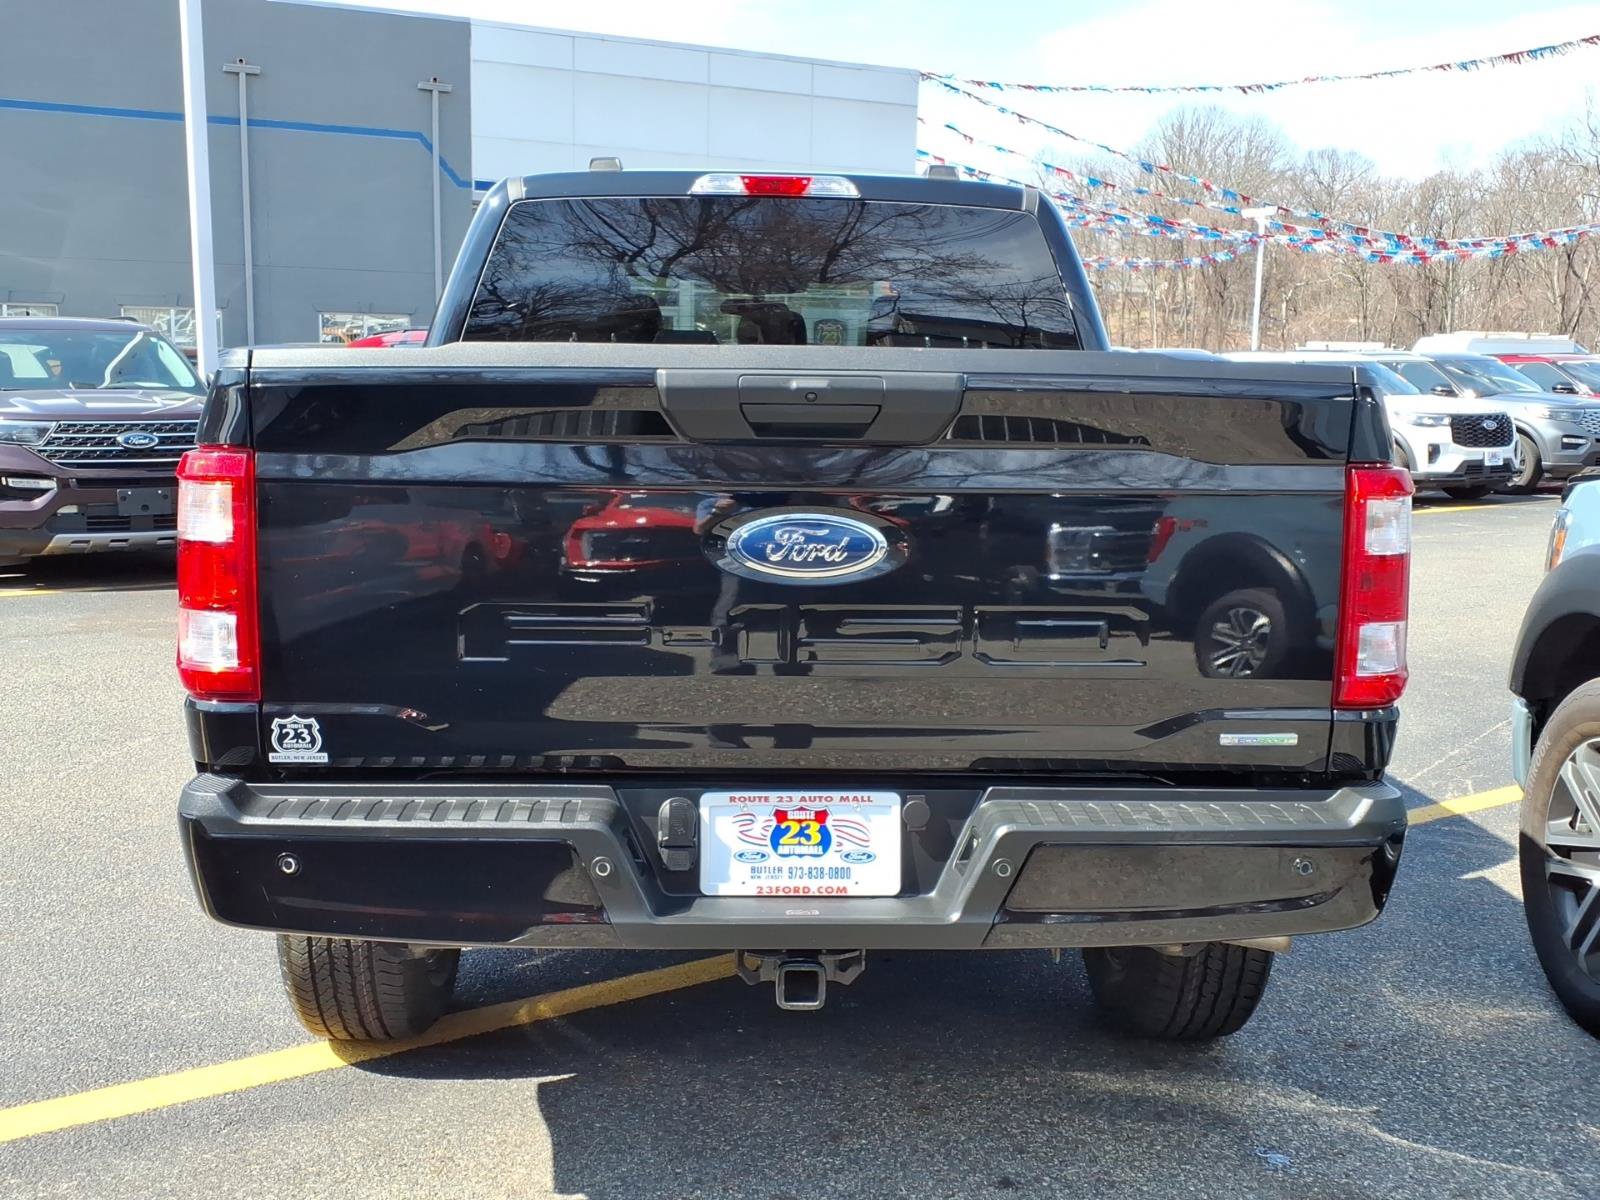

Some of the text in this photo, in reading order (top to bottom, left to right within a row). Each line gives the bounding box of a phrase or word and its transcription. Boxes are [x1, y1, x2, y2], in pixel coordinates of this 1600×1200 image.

[128, 436, 149, 444] Ford
[766, 527, 850, 561] Ford
[281, 728, 311, 744] 23
[729, 795, 873, 803] ROUTE 23 AUTO MALL
[779, 820, 822, 846] 23
[750, 866, 783, 874] BUTLER
[788, 866, 851, 880] 973-838-0800
[756, 886, 848, 895] 23FORD.COM
